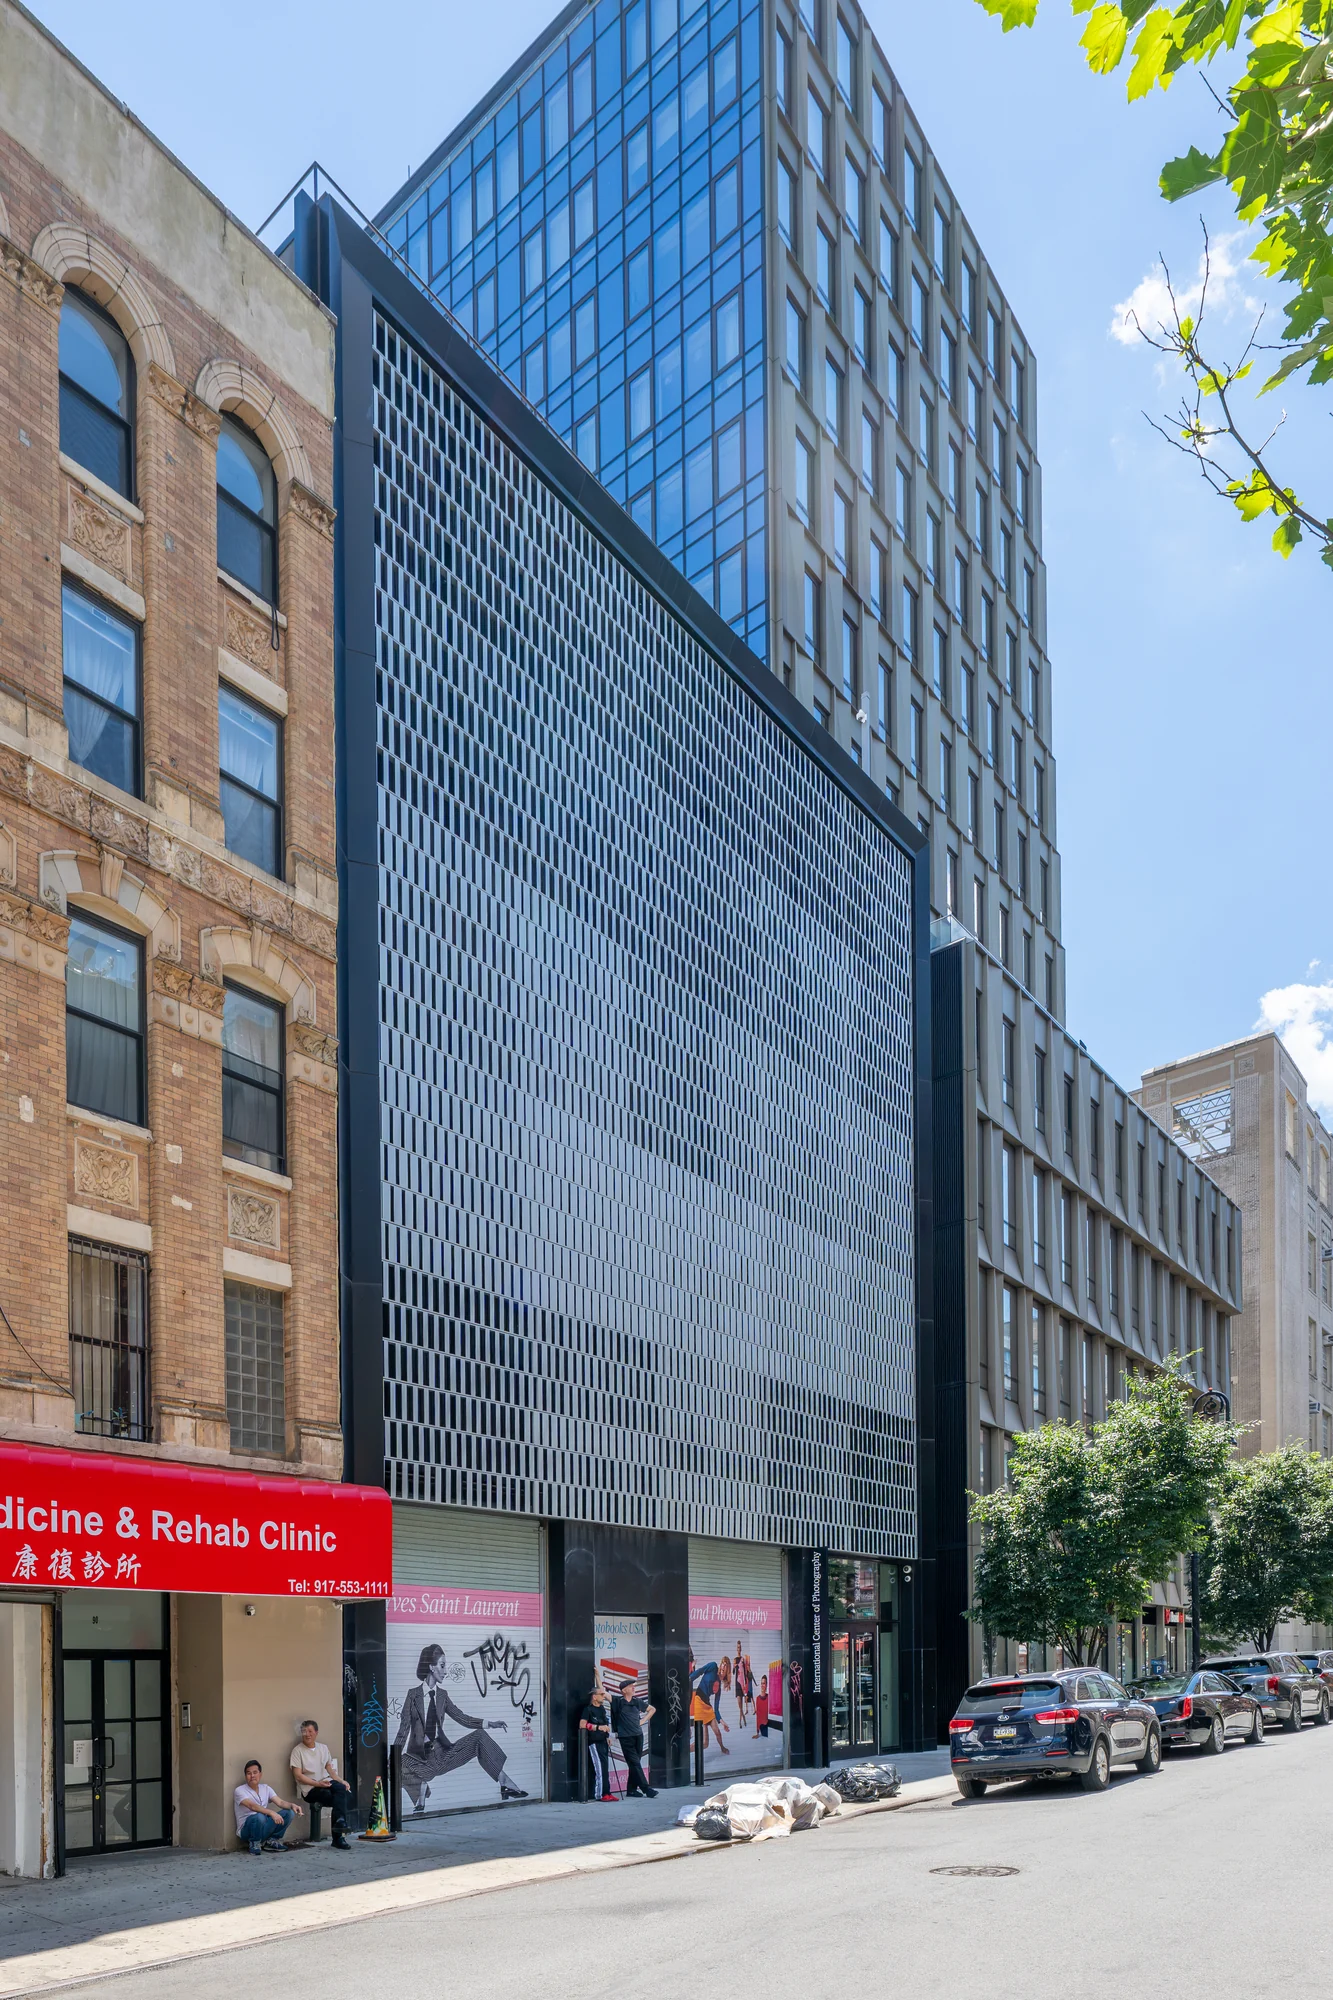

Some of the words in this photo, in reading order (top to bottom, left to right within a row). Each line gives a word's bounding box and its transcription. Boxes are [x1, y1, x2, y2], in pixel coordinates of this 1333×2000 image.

[0, 1496, 104, 1536] dicine
[116, 1506, 140, 1539] &
[152, 1510, 250, 1548] Rehab
[260, 1521, 337, 1552] Clinic
[12, 1543, 142, 1585] 康復診所
[288, 1579, 311, 1593] Tel:
[314, 1580, 388, 1594] 917-553-1111
[811, 1551, 822, 1602] Photography
[420, 1593, 460, 1615] Saint
[463, 1595, 519, 1617] Laurent
[690, 1604, 709, 1621] and
[711, 1605, 768, 1626] Photography
[811, 1603, 820, 1613] of
[629, 1622, 644, 1635] USA
[812, 1614, 821, 1641] Center
[813, 1642, 821, 1693] International
[1156, 1665, 1162, 1673] P
